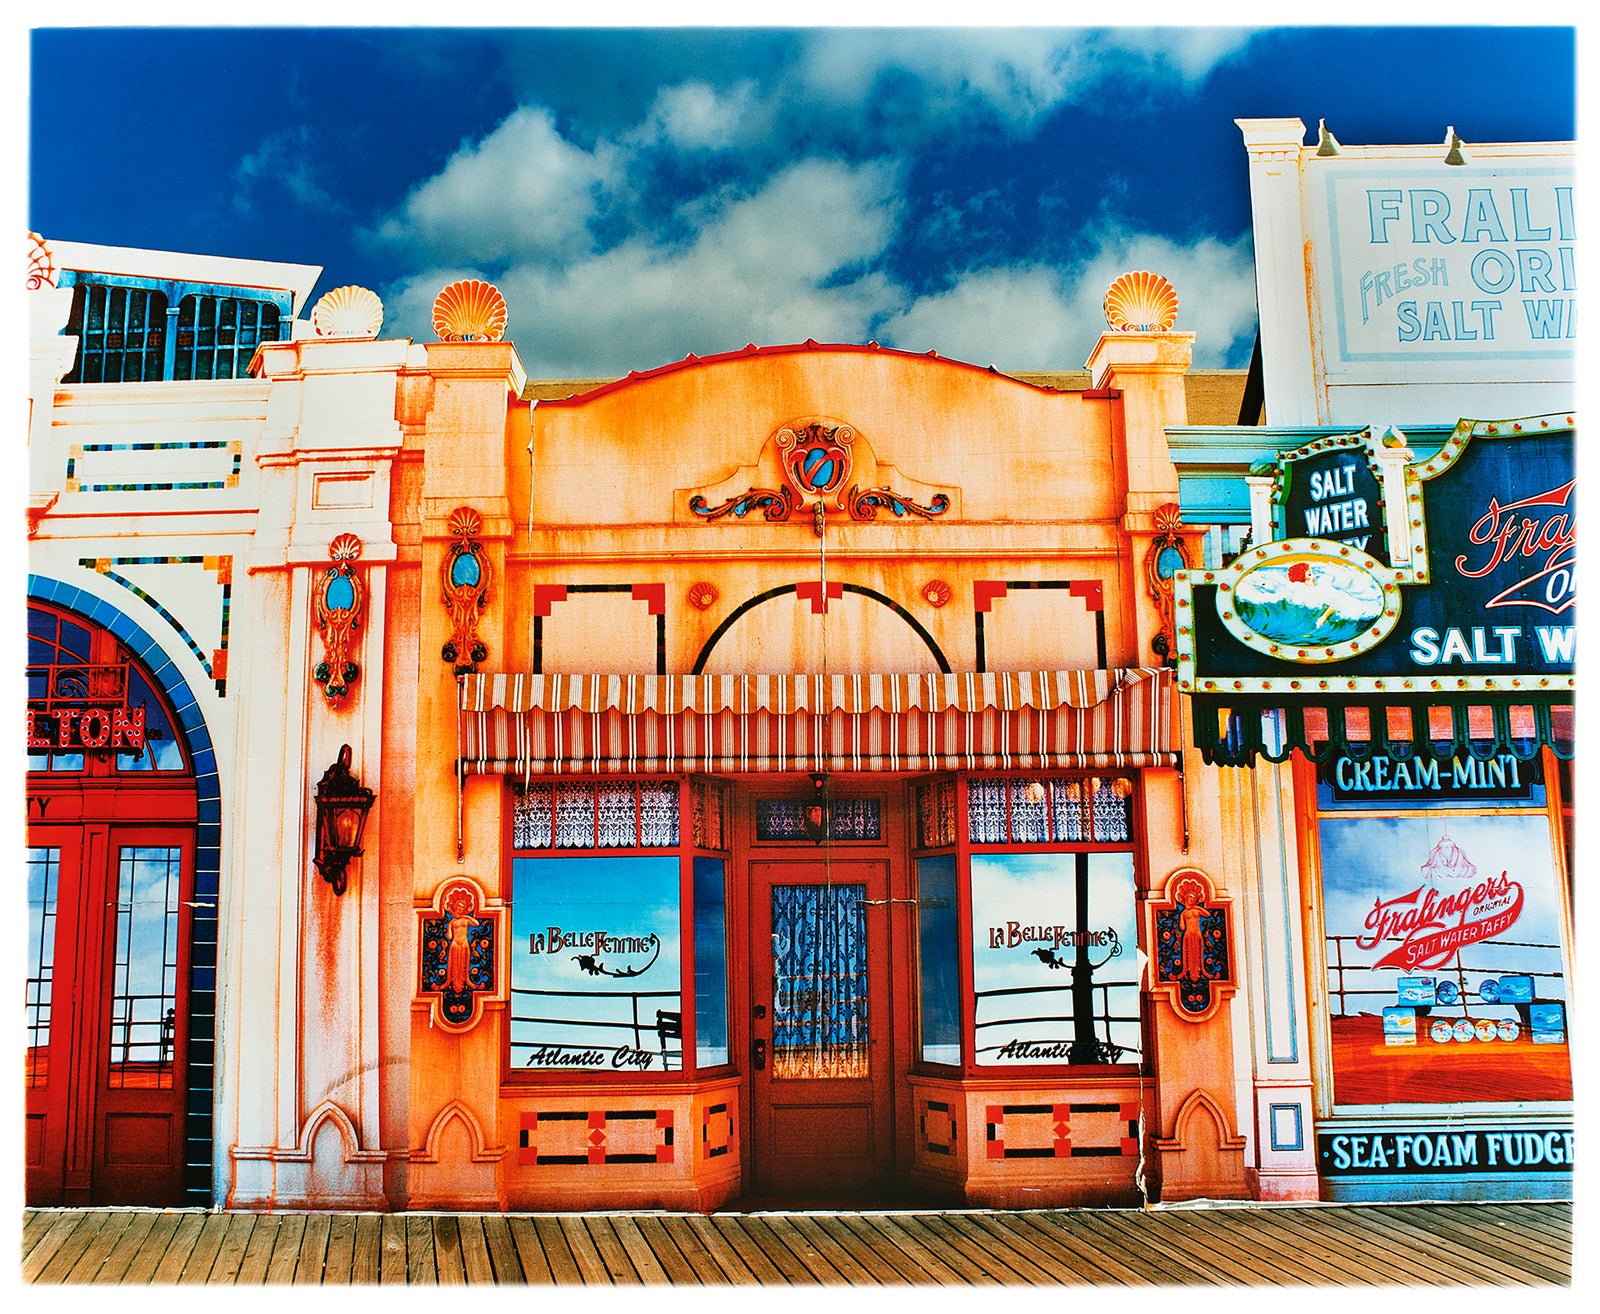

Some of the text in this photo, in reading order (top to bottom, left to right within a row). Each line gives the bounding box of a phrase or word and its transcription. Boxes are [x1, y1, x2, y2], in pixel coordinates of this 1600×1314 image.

[1359, 257, 1449, 326] FRESH
[1397, 300, 1502, 342] SALT
[1309, 463, 1356, 502] SALT
[1303, 497, 1370, 537] WATER
[1455, 478, 1577, 579] Fra
[1409, 625, 1576, 664] SALT W
[1335, 754, 1522, 792] CREAM-MINT
[1406, 912, 1513, 965] SALT WATER TAFFY
[526, 1045, 653, 1069] Atlantic City
[1332, 1133, 1478, 1169] SEA-FOAM
